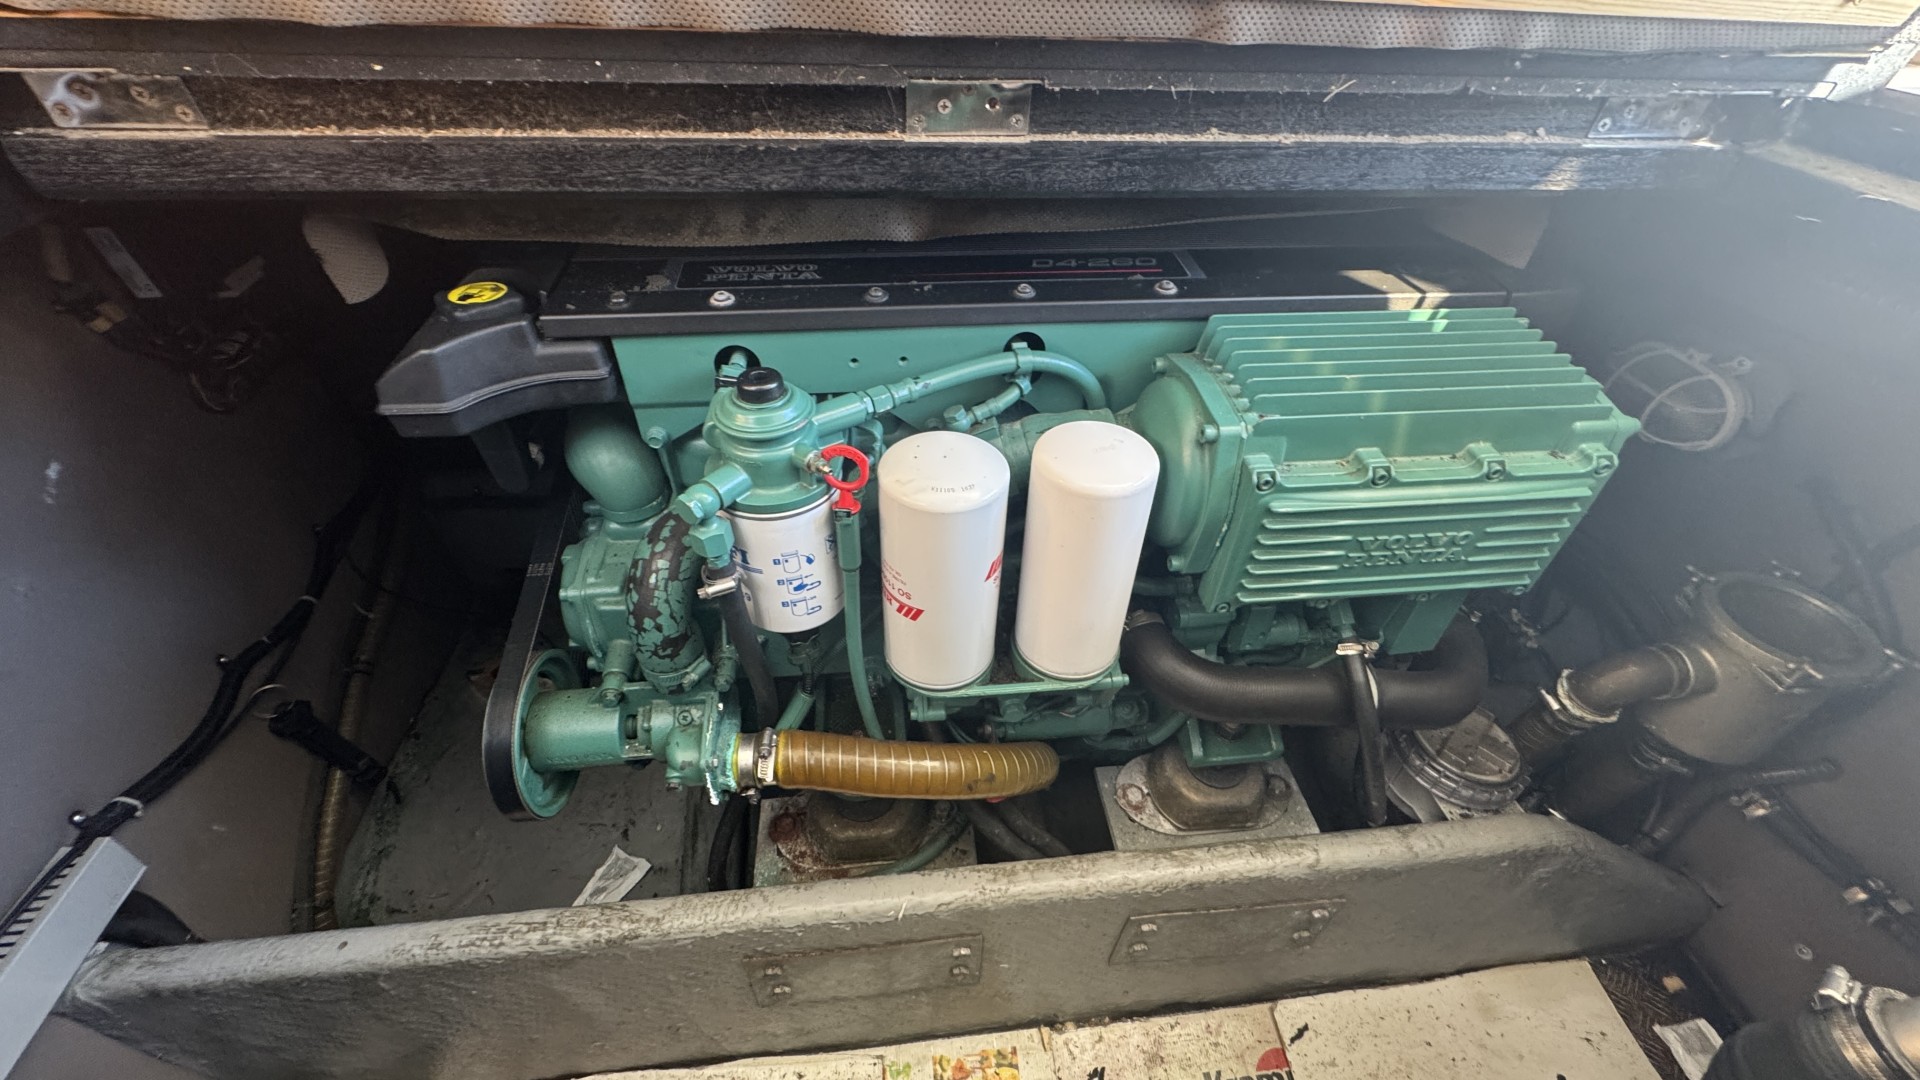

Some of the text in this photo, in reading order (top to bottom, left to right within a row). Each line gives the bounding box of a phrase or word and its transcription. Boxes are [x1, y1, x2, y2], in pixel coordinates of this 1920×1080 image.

[710, 263, 819, 273] VOLVO
[1031, 257, 1158, 268] D4-260
[704, 271, 823, 282] PENTA
[1357, 531, 1475, 551] VOLVO
[1343, 547, 1467, 568] PENTA
[897, 588, 912, 600] SO
